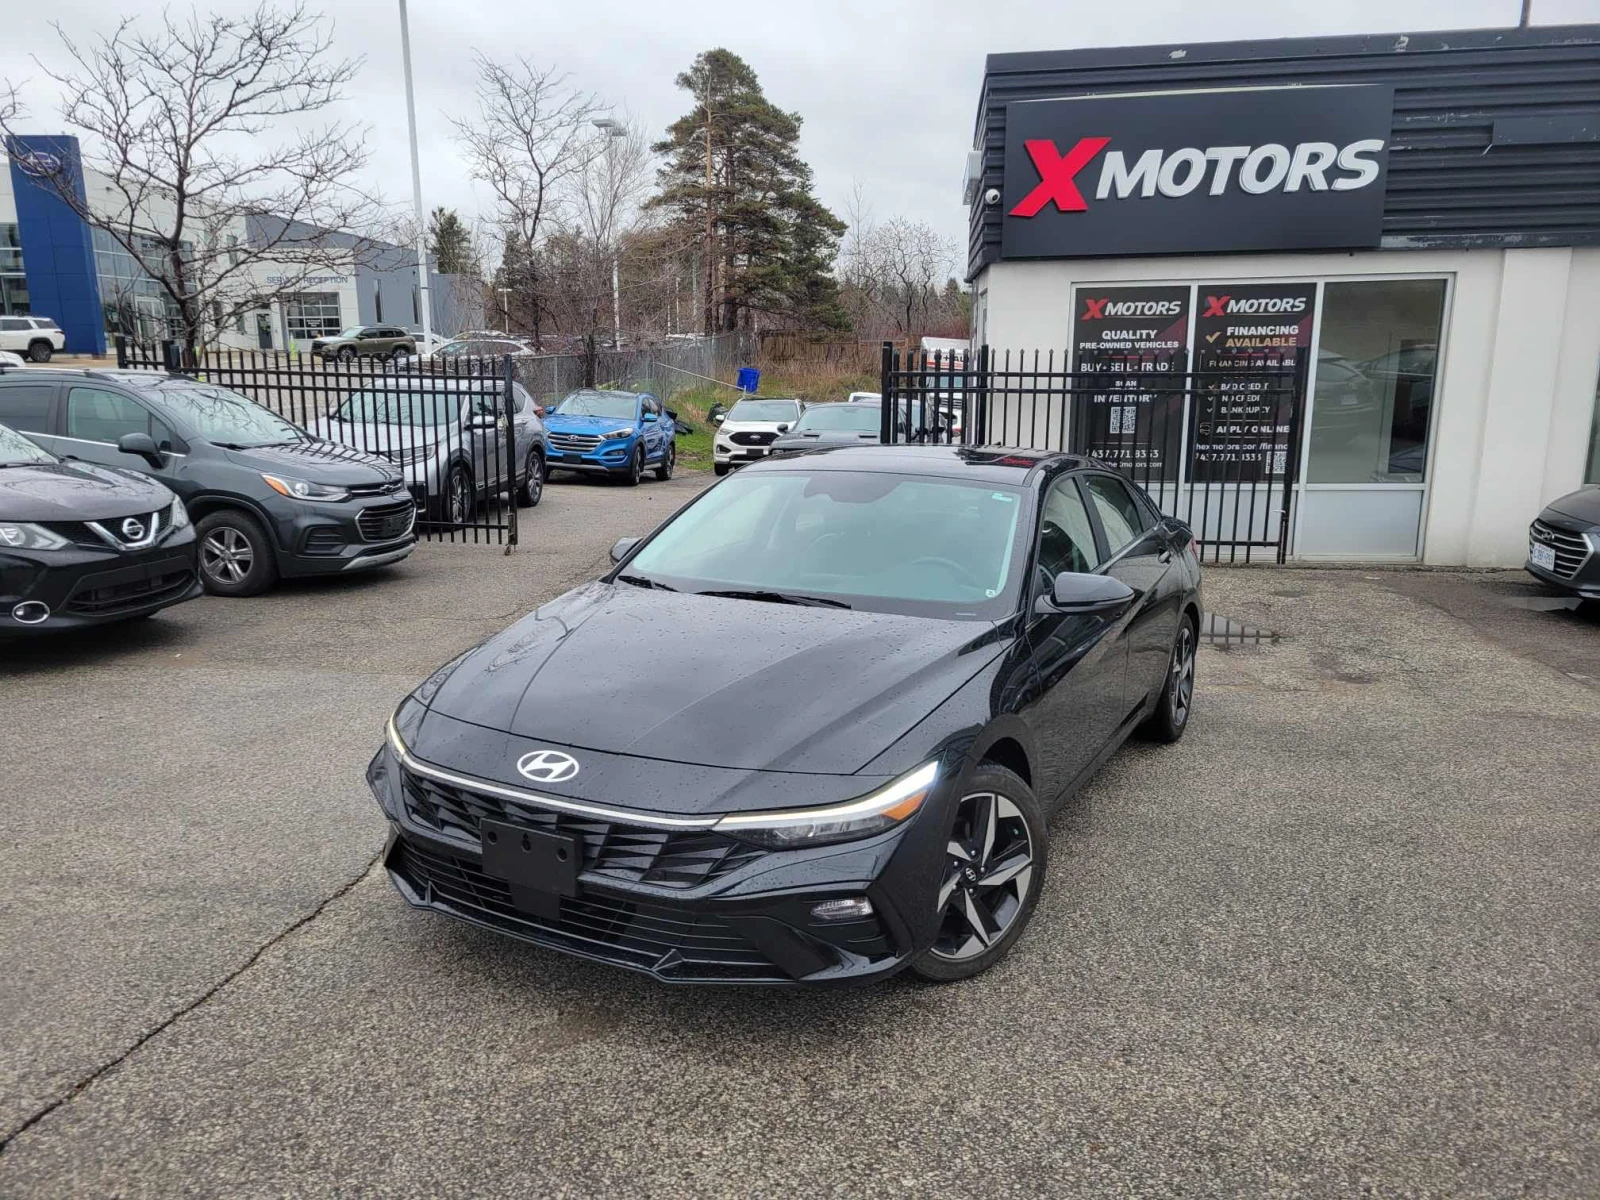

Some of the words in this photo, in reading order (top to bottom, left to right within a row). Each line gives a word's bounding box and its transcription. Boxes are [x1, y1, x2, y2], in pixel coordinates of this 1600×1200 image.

[1102, 329, 1158, 340] QUALITY
[1226, 325, 1299, 336] FINANCING
[1079, 341, 1132, 350] PRE-OWNED
[1134, 341, 1179, 349] VEHICLES
[1225, 337, 1298, 348] AVAILABLE
[1080, 363, 1102, 372] BUY
